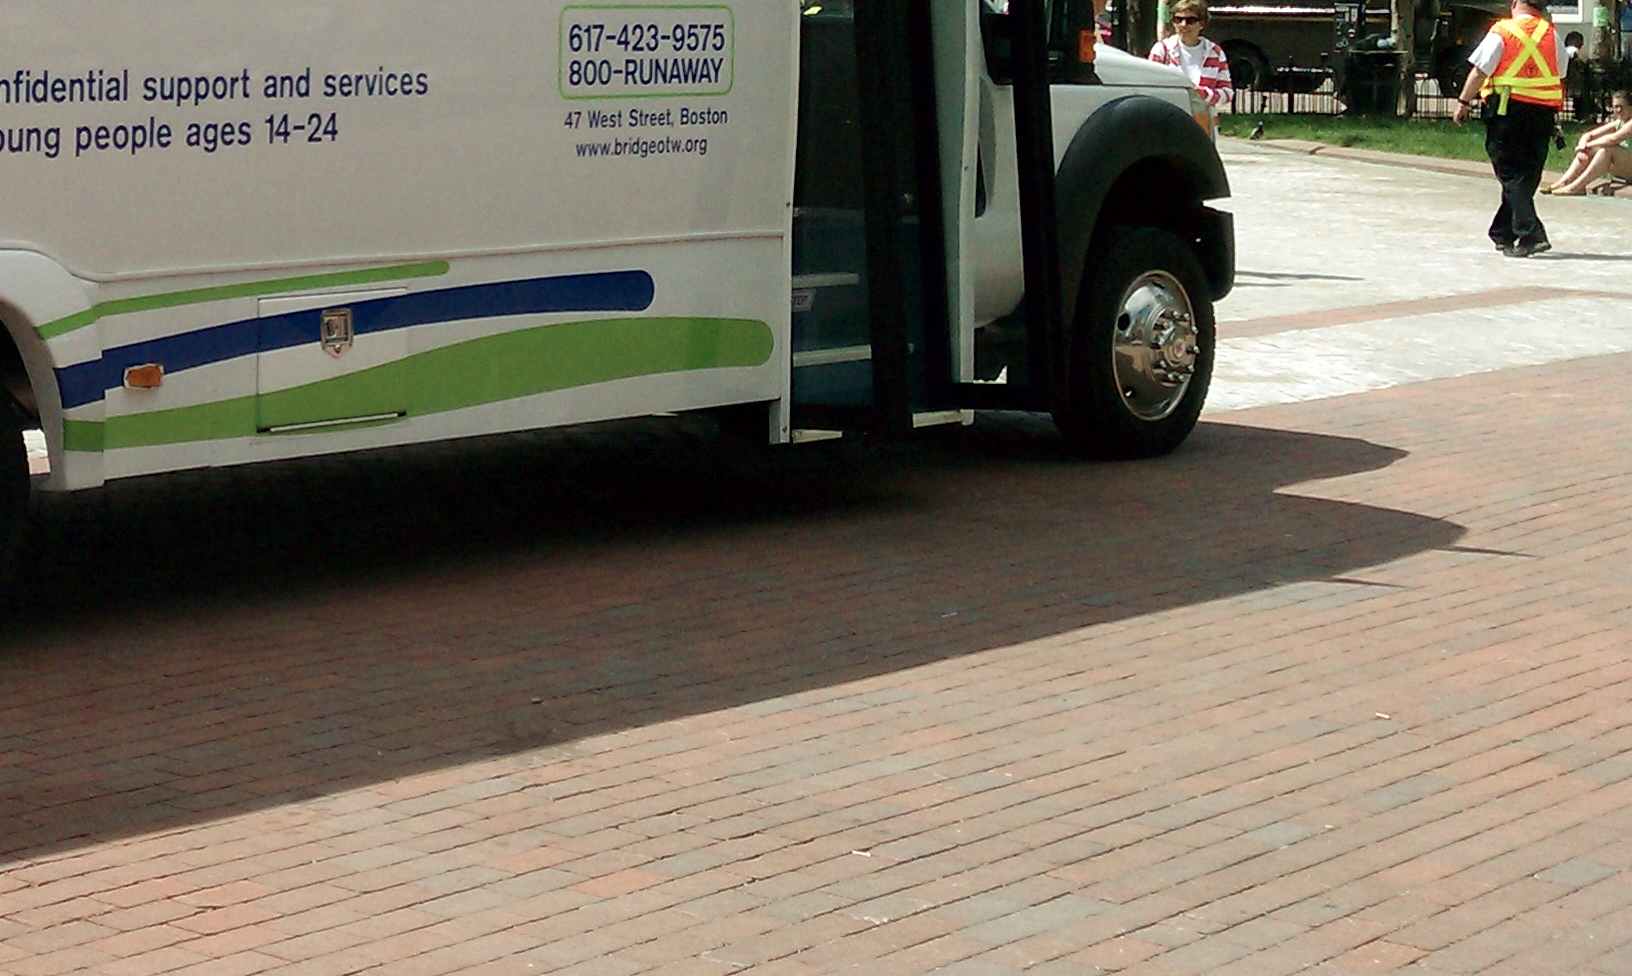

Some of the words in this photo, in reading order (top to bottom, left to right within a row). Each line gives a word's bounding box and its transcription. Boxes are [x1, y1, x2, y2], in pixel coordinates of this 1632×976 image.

[568, 24, 726, 53] 617-423-9575
[142, 69, 251, 106] support
[263, 67, 310, 98] and
[323, 68, 429, 97] services
[568, 58, 725, 87] 800-RUNAWAY
[564, 111, 582, 129] 47
[588, 110, 622, 129] West
[629, 108, 674, 128] Street,
[680, 107, 728, 126] Boston
[75, 117, 172, 158] people
[186, 120, 252, 148] ages
[264, 113, 339, 145] 14-24
[575, 136, 708, 158] www.bridgeotw.org
